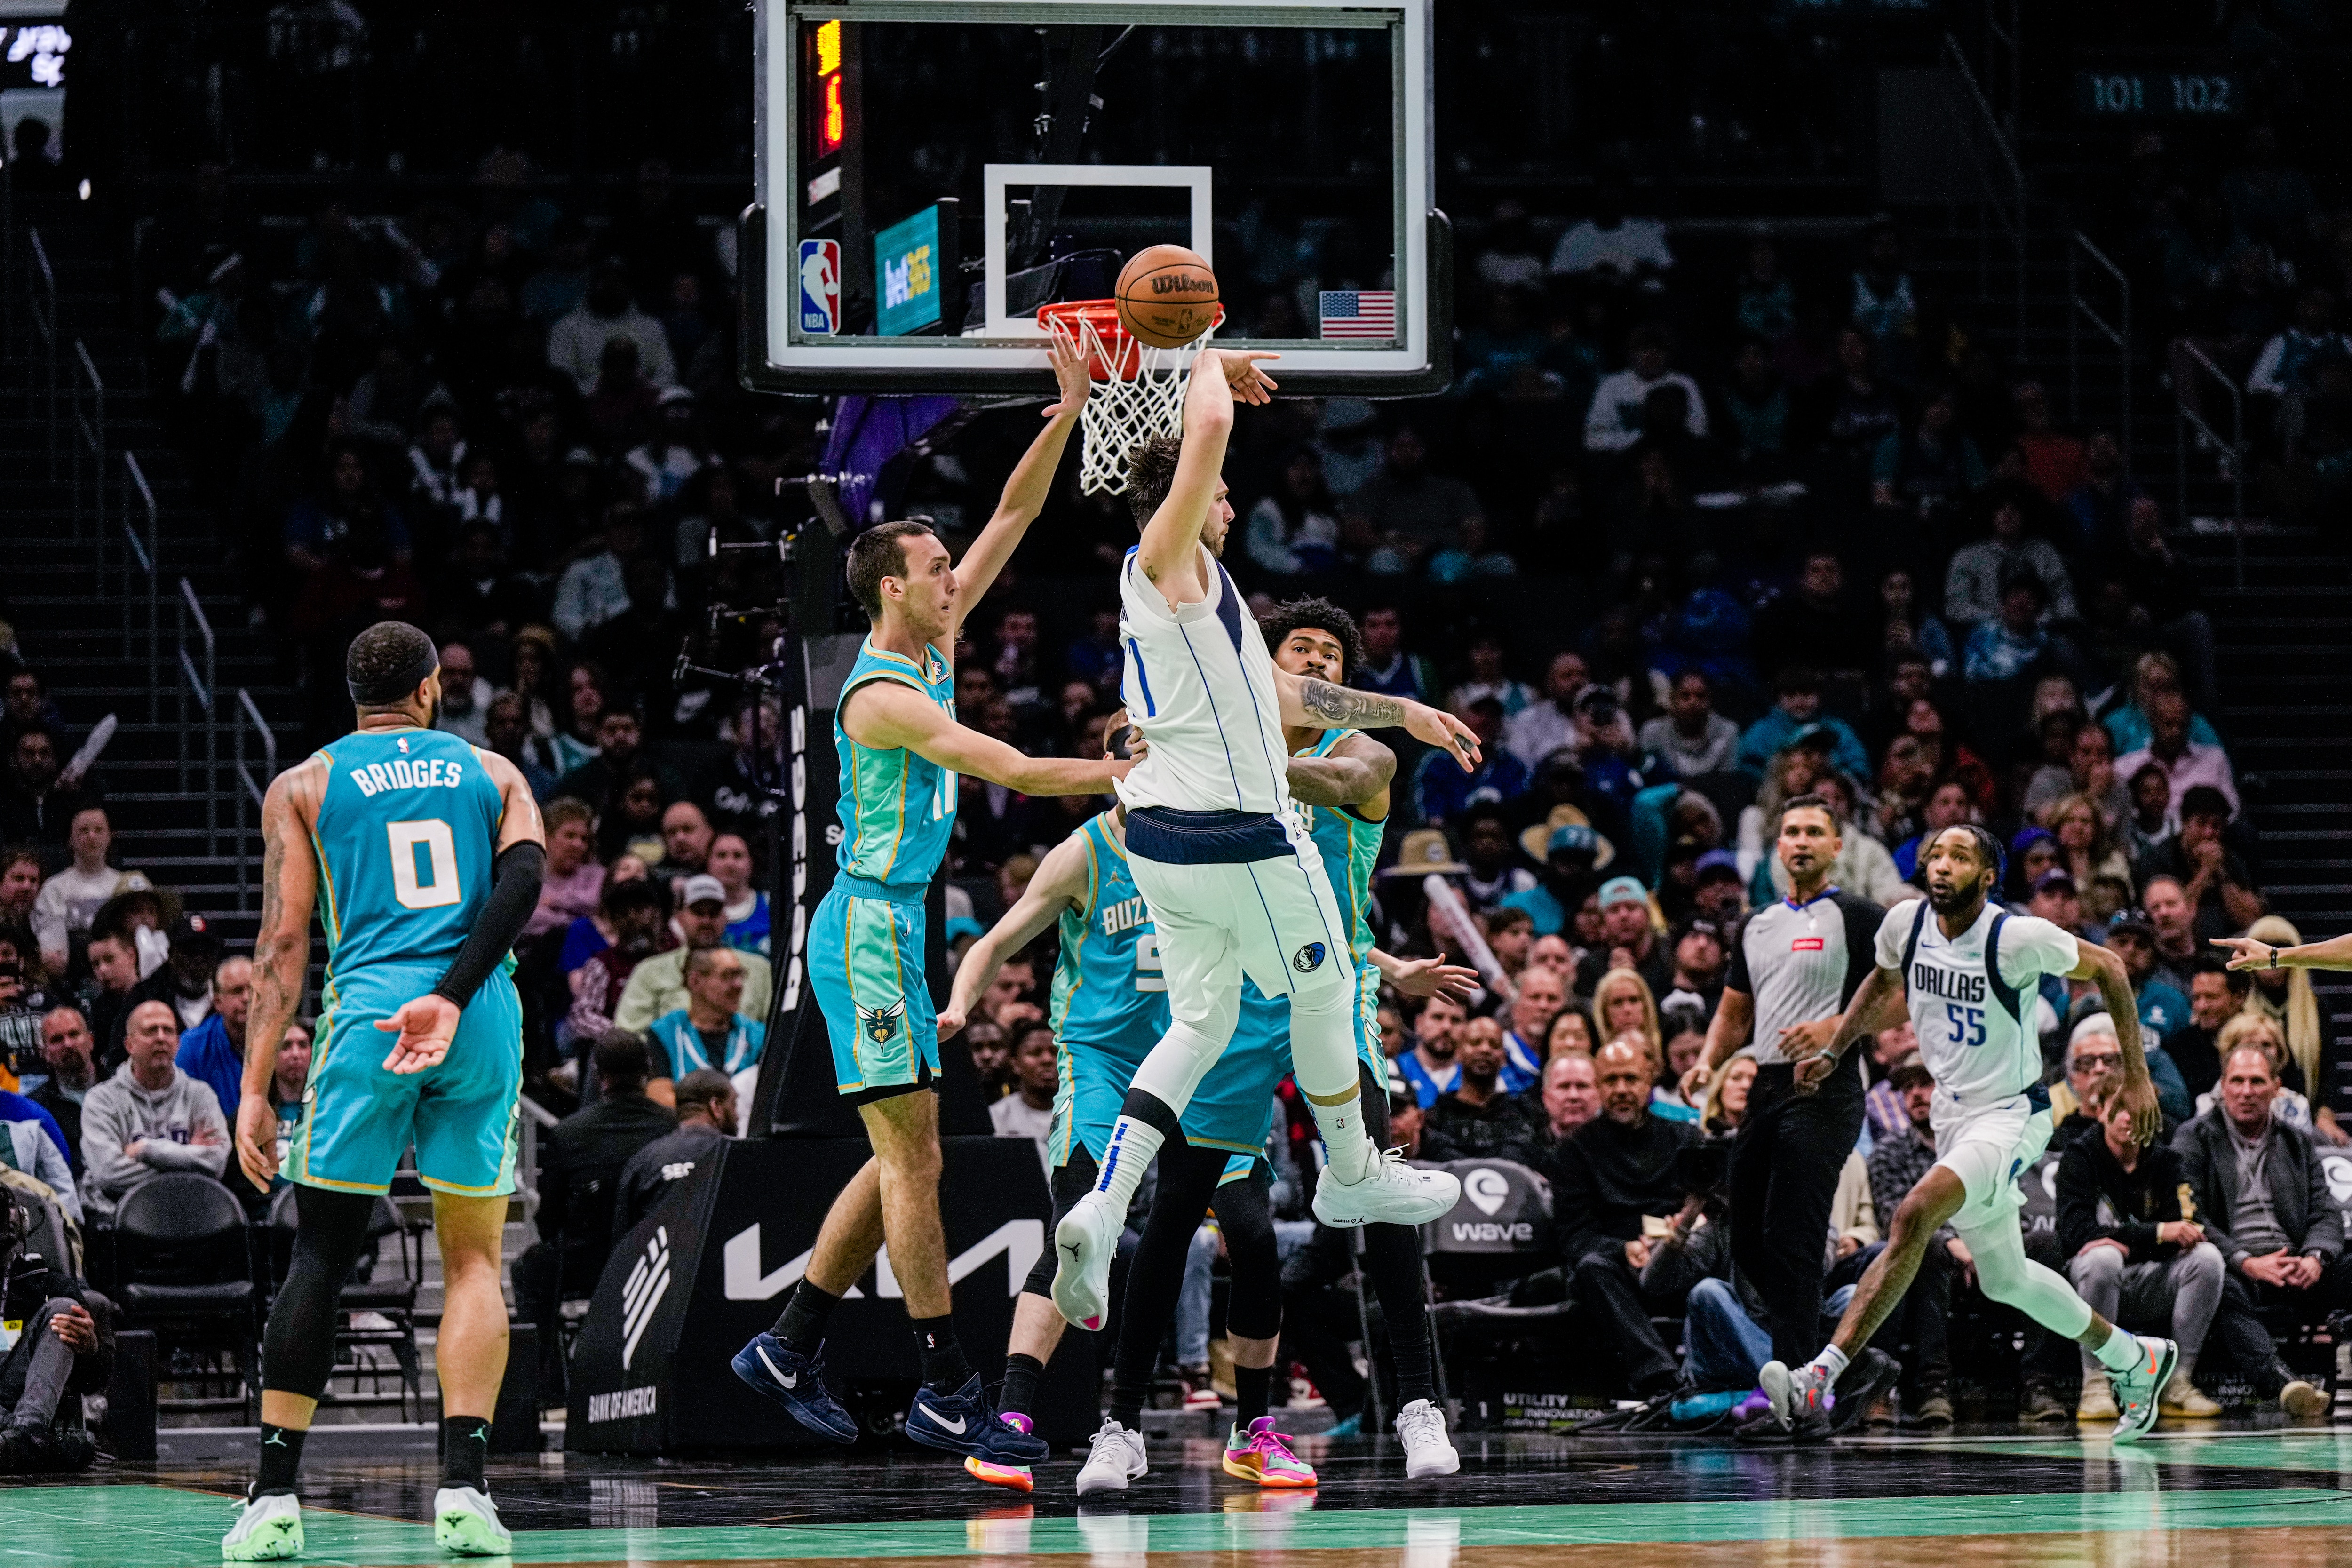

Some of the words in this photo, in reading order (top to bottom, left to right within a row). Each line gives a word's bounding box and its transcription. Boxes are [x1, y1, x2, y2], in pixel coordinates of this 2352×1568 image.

[2091, 74, 2143, 111] 101
[2169, 74, 2233, 112] 102
[1149, 273, 1214, 294] Wilson
[804, 313, 825, 328] NBA
[350, 759, 463, 797] BRIDGES
[386, 818, 462, 910] 0
[1915, 963, 1985, 1003] DALLAS
[1946, 1003, 1986, 1046] 55
[1452, 1222, 1534, 1242] wave
[620, 1385, 657, 1419] AMERICA
[1503, 1392, 1569, 1409] UTILITY
